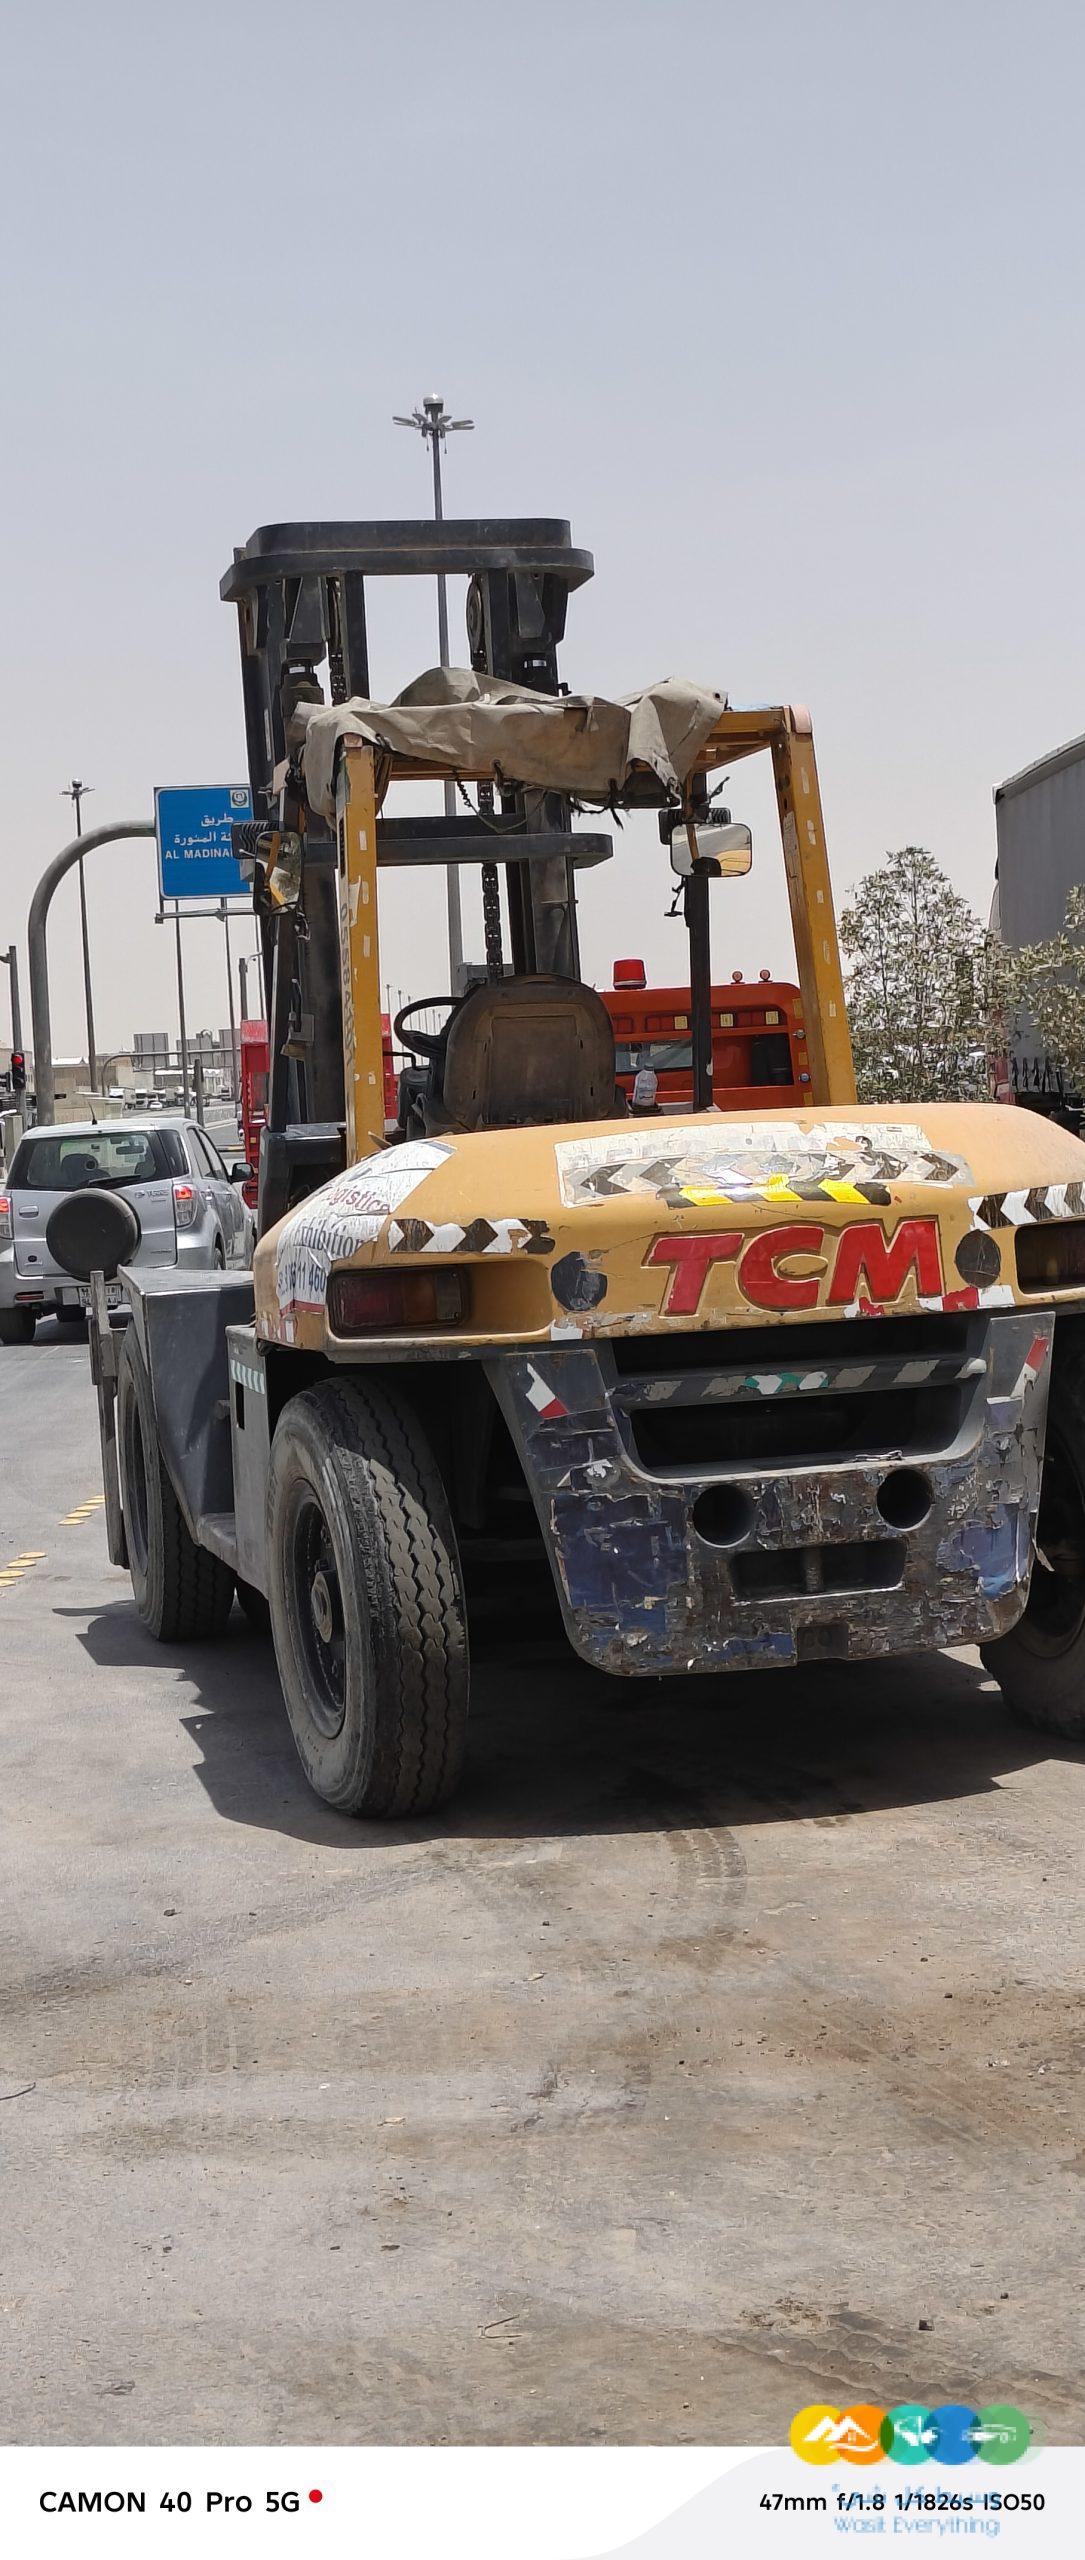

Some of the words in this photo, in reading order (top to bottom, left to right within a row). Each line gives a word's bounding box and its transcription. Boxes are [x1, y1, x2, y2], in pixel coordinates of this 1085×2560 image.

[201, 813, 234, 827] طريق
[174, 831, 217, 846] المنورة
[165, 850, 179, 859] AL
[640, 1215, 946, 1318] TCM
